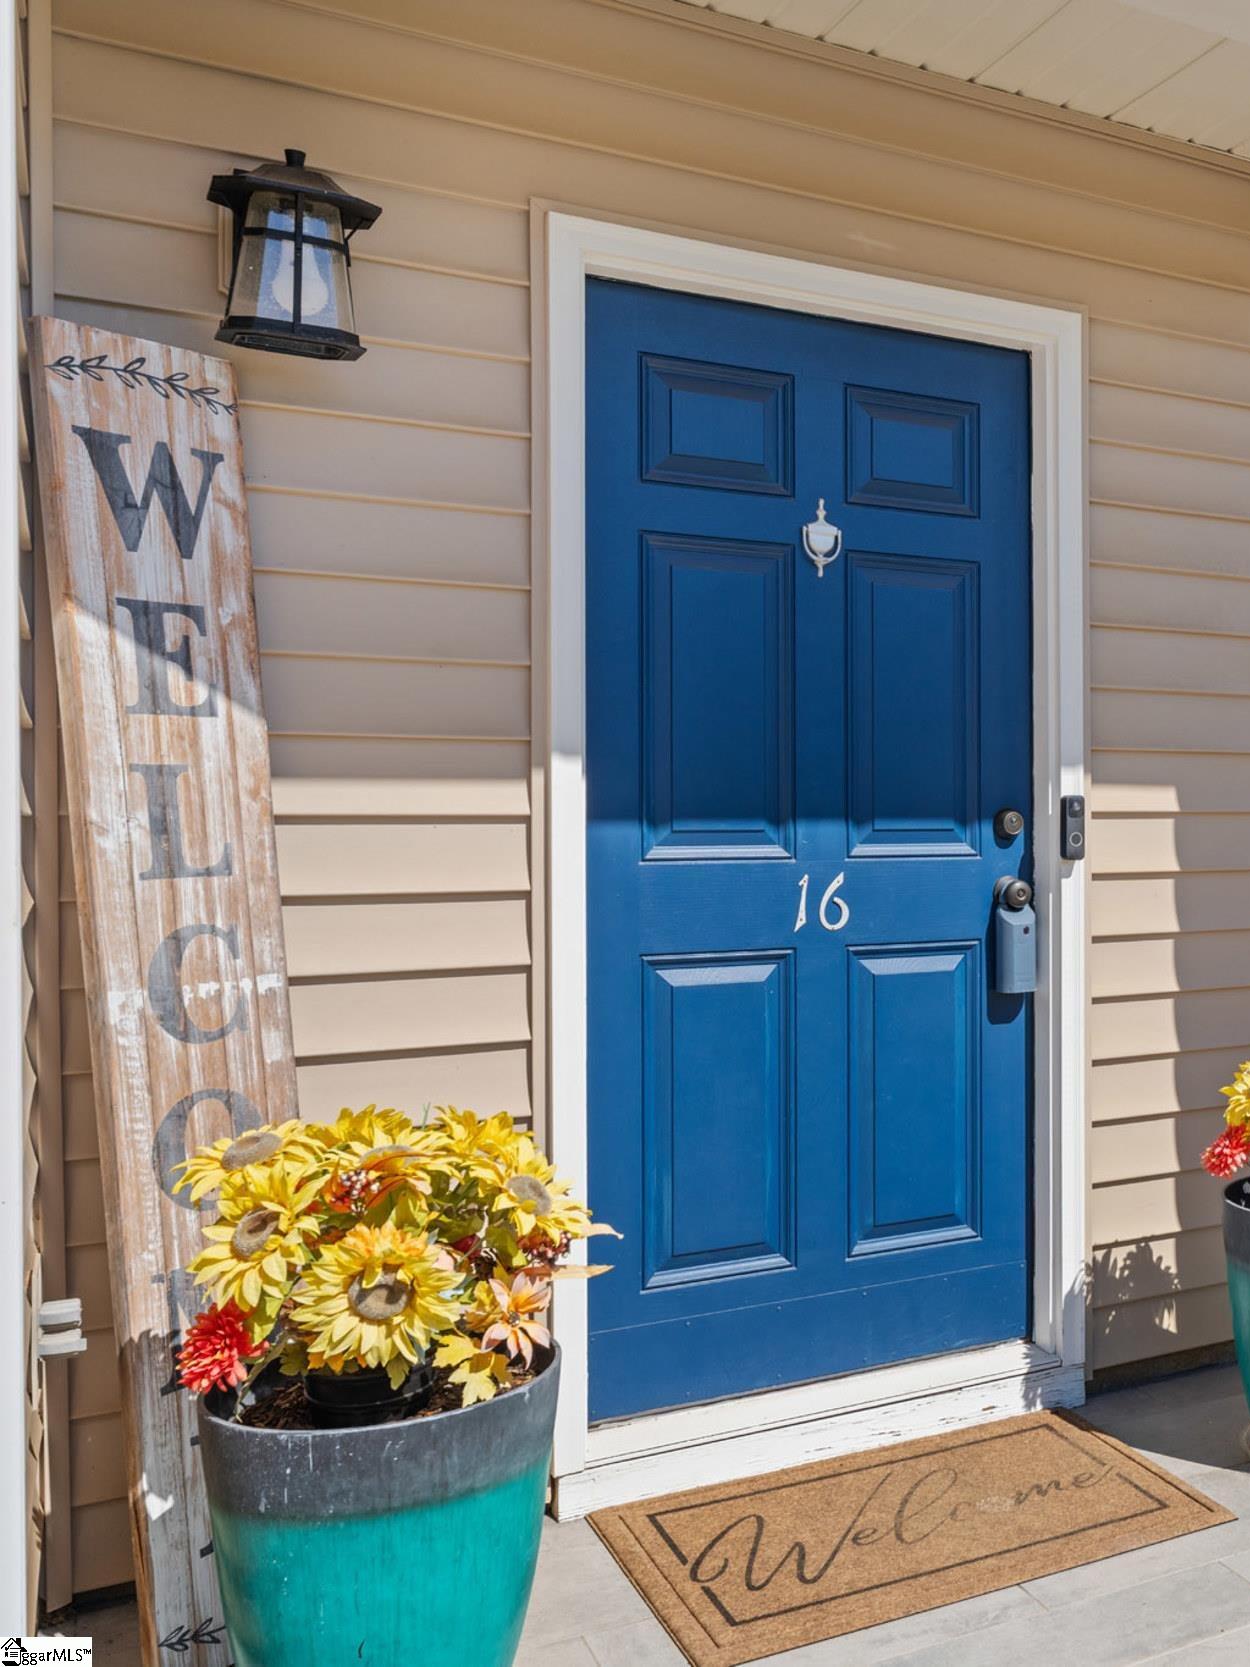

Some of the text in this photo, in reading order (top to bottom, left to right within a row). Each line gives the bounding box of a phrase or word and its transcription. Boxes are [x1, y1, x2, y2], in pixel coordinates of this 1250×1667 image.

[794, 872, 849, 932] 16
[72, 425, 262, 1556] WELCO
[690, 1466, 1114, 1591] Welcme
